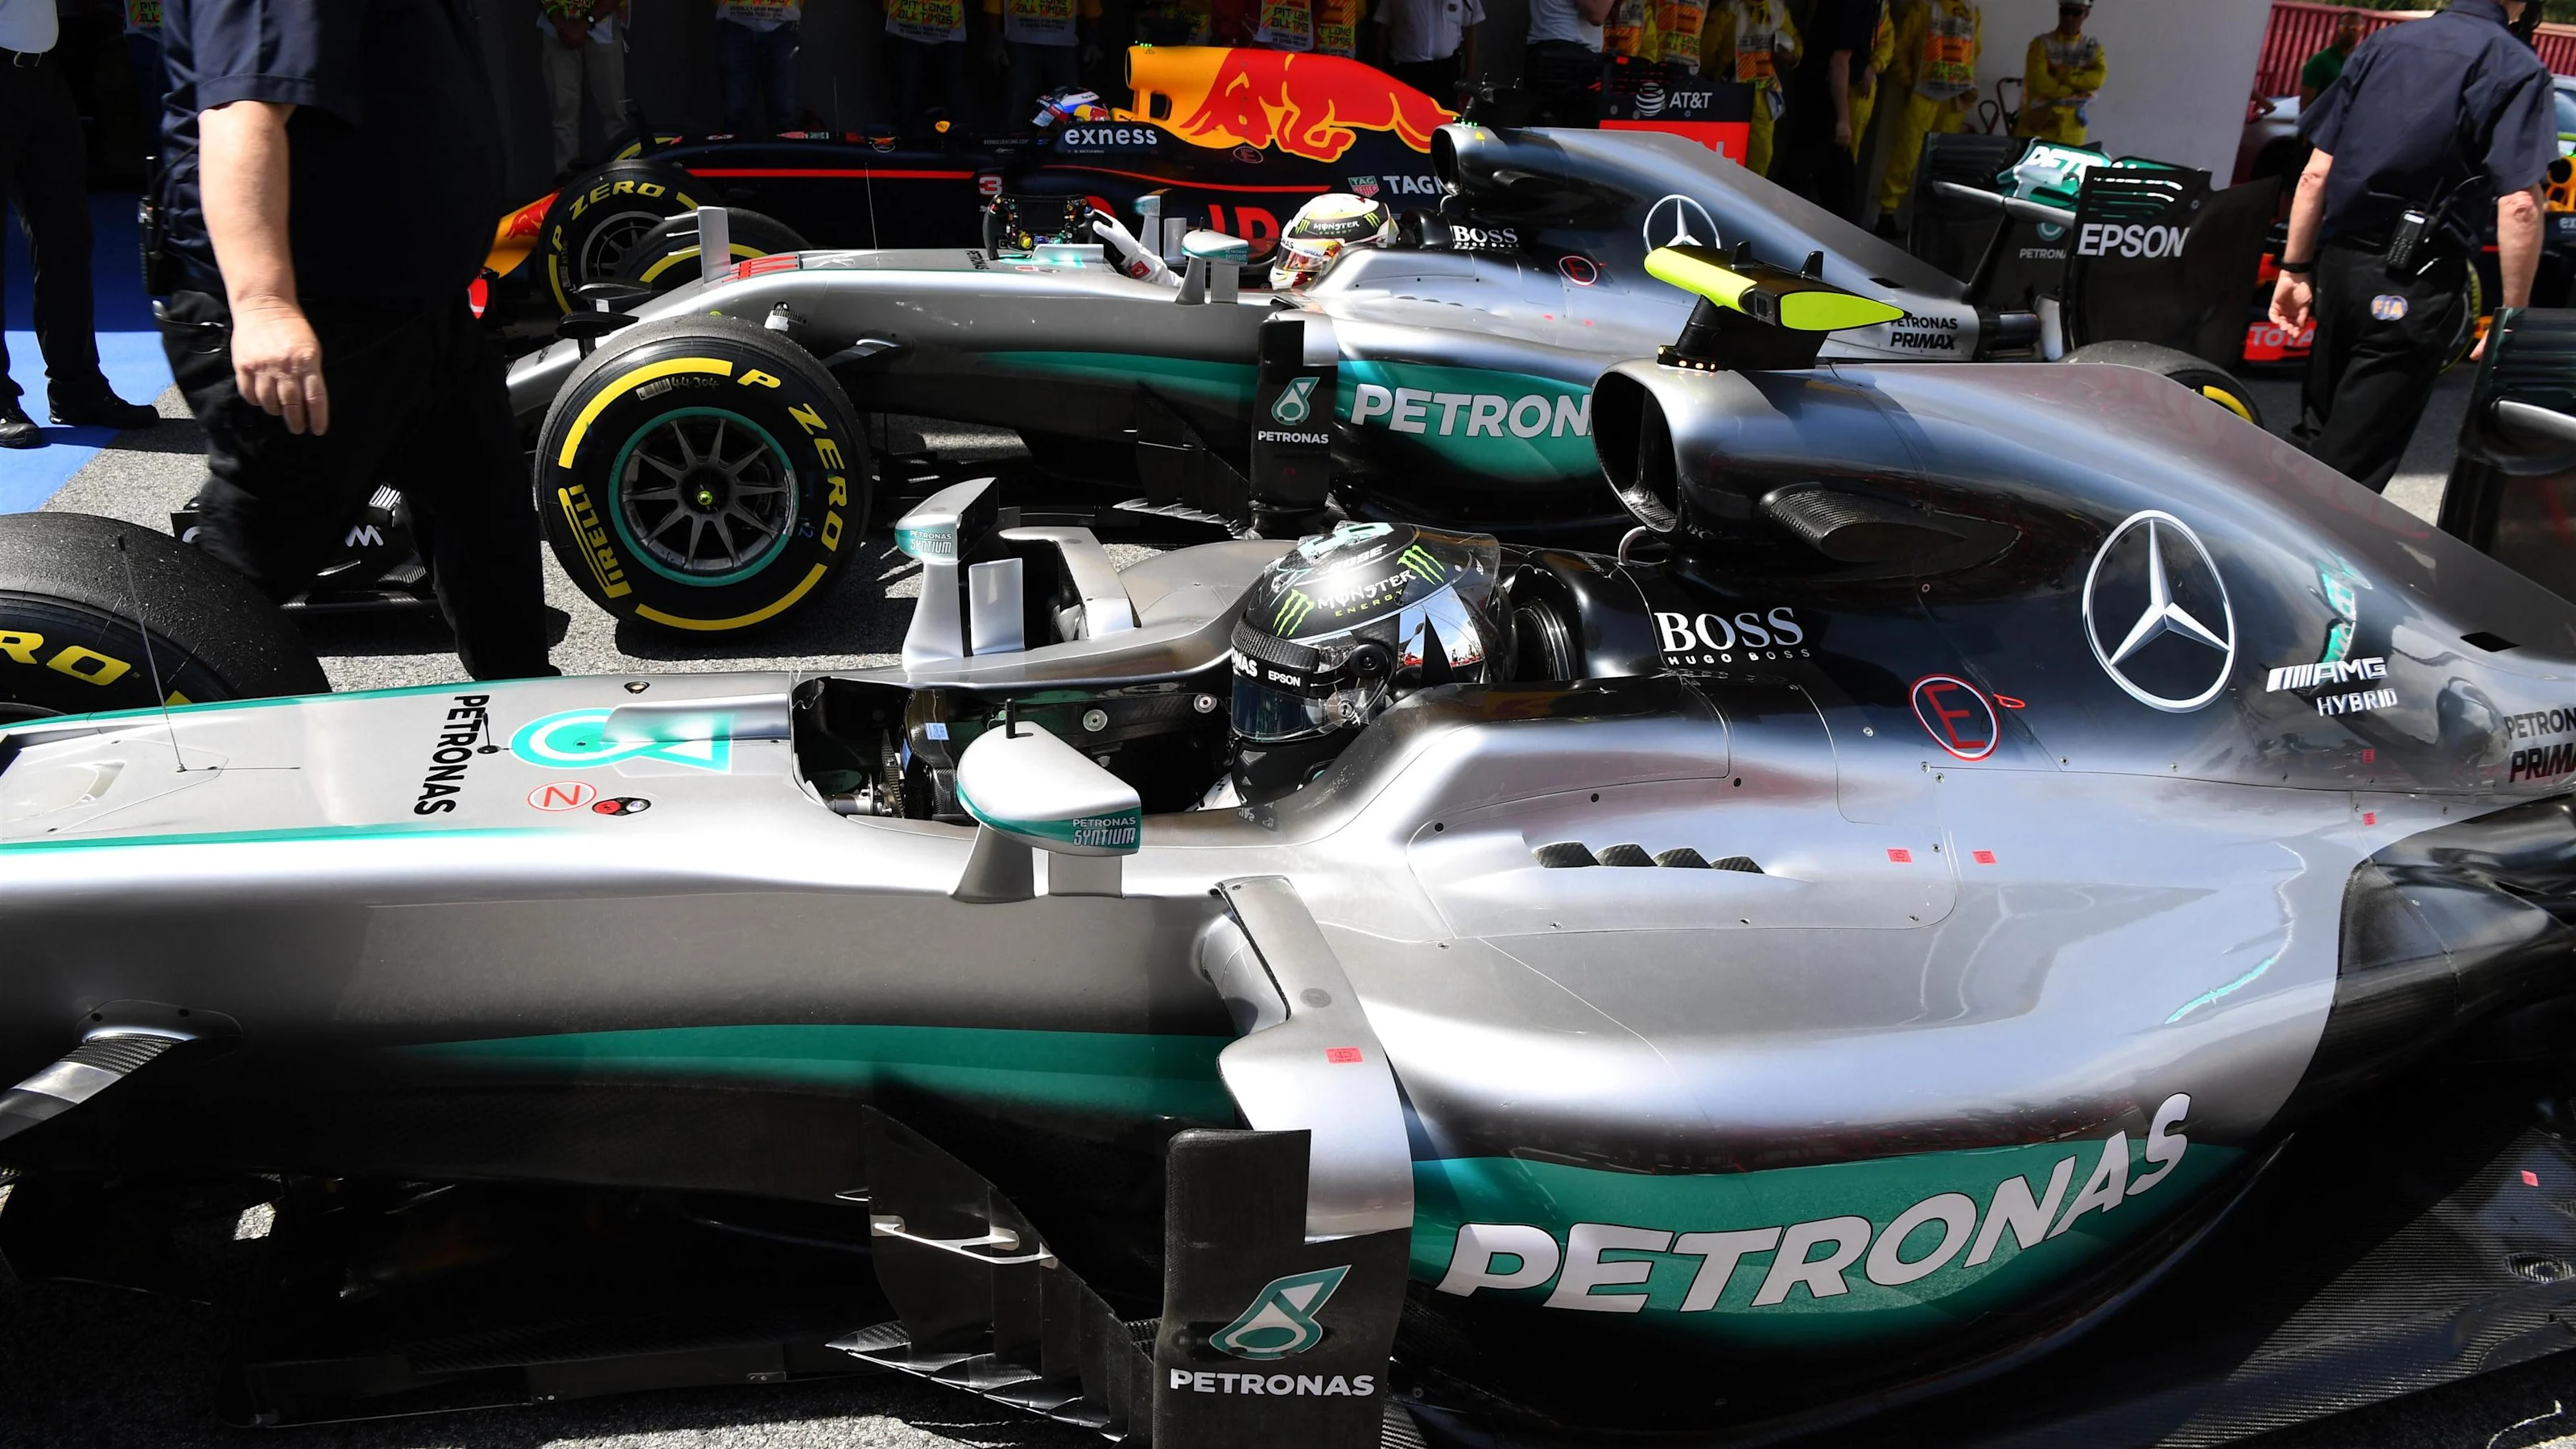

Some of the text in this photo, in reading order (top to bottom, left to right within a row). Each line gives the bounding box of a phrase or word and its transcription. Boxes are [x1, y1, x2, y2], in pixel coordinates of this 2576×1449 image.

[1669, 92, 1713, 109] AT&T
[1064, 128, 1158, 146] exness
[978, 175, 1003, 196] 3
[1352, 177, 1374, 185] TAG
[551, 180, 667, 252] P ZERO
[1313, 220, 1360, 232] MONSTER
[1452, 225, 1518, 243] BOSS
[2077, 223, 2190, 258] EPSON
[1565, 258, 1591, 282] E
[1890, 332, 1955, 350] PRIMAX
[1350, 382, 1591, 439] PETRON
[1257, 429, 1330, 445] PETRONAS
[737, 369, 848, 551] P ZERO
[559, 483, 633, 599] PIRELLI
[910, 530, 952, 540] PETRONAS
[910, 539, 952, 554] SYNTIUM
[1318, 569, 1417, 610] MONSTER
[1335, 588, 1403, 617] ENERGY
[1654, 607, 1804, 653] BOSS
[1667, 649, 1810, 666] HUGO BOSS
[1268, 670, 1302, 687] EPSON
[2314, 657, 2389, 686] AMG
[2316, 688, 2398, 717] HYBRID
[1923, 683, 1987, 750] E
[414, 695, 489, 815] PETRONAS
[543, 784, 580, 807] N
[1072, 816, 1137, 828] PETRONAS
[1073, 827, 1137, 846] SYNTIUM
[1435, 1092, 2193, 1314] PETRONAS
[1170, 1368, 1376, 1397] PETRONAS
